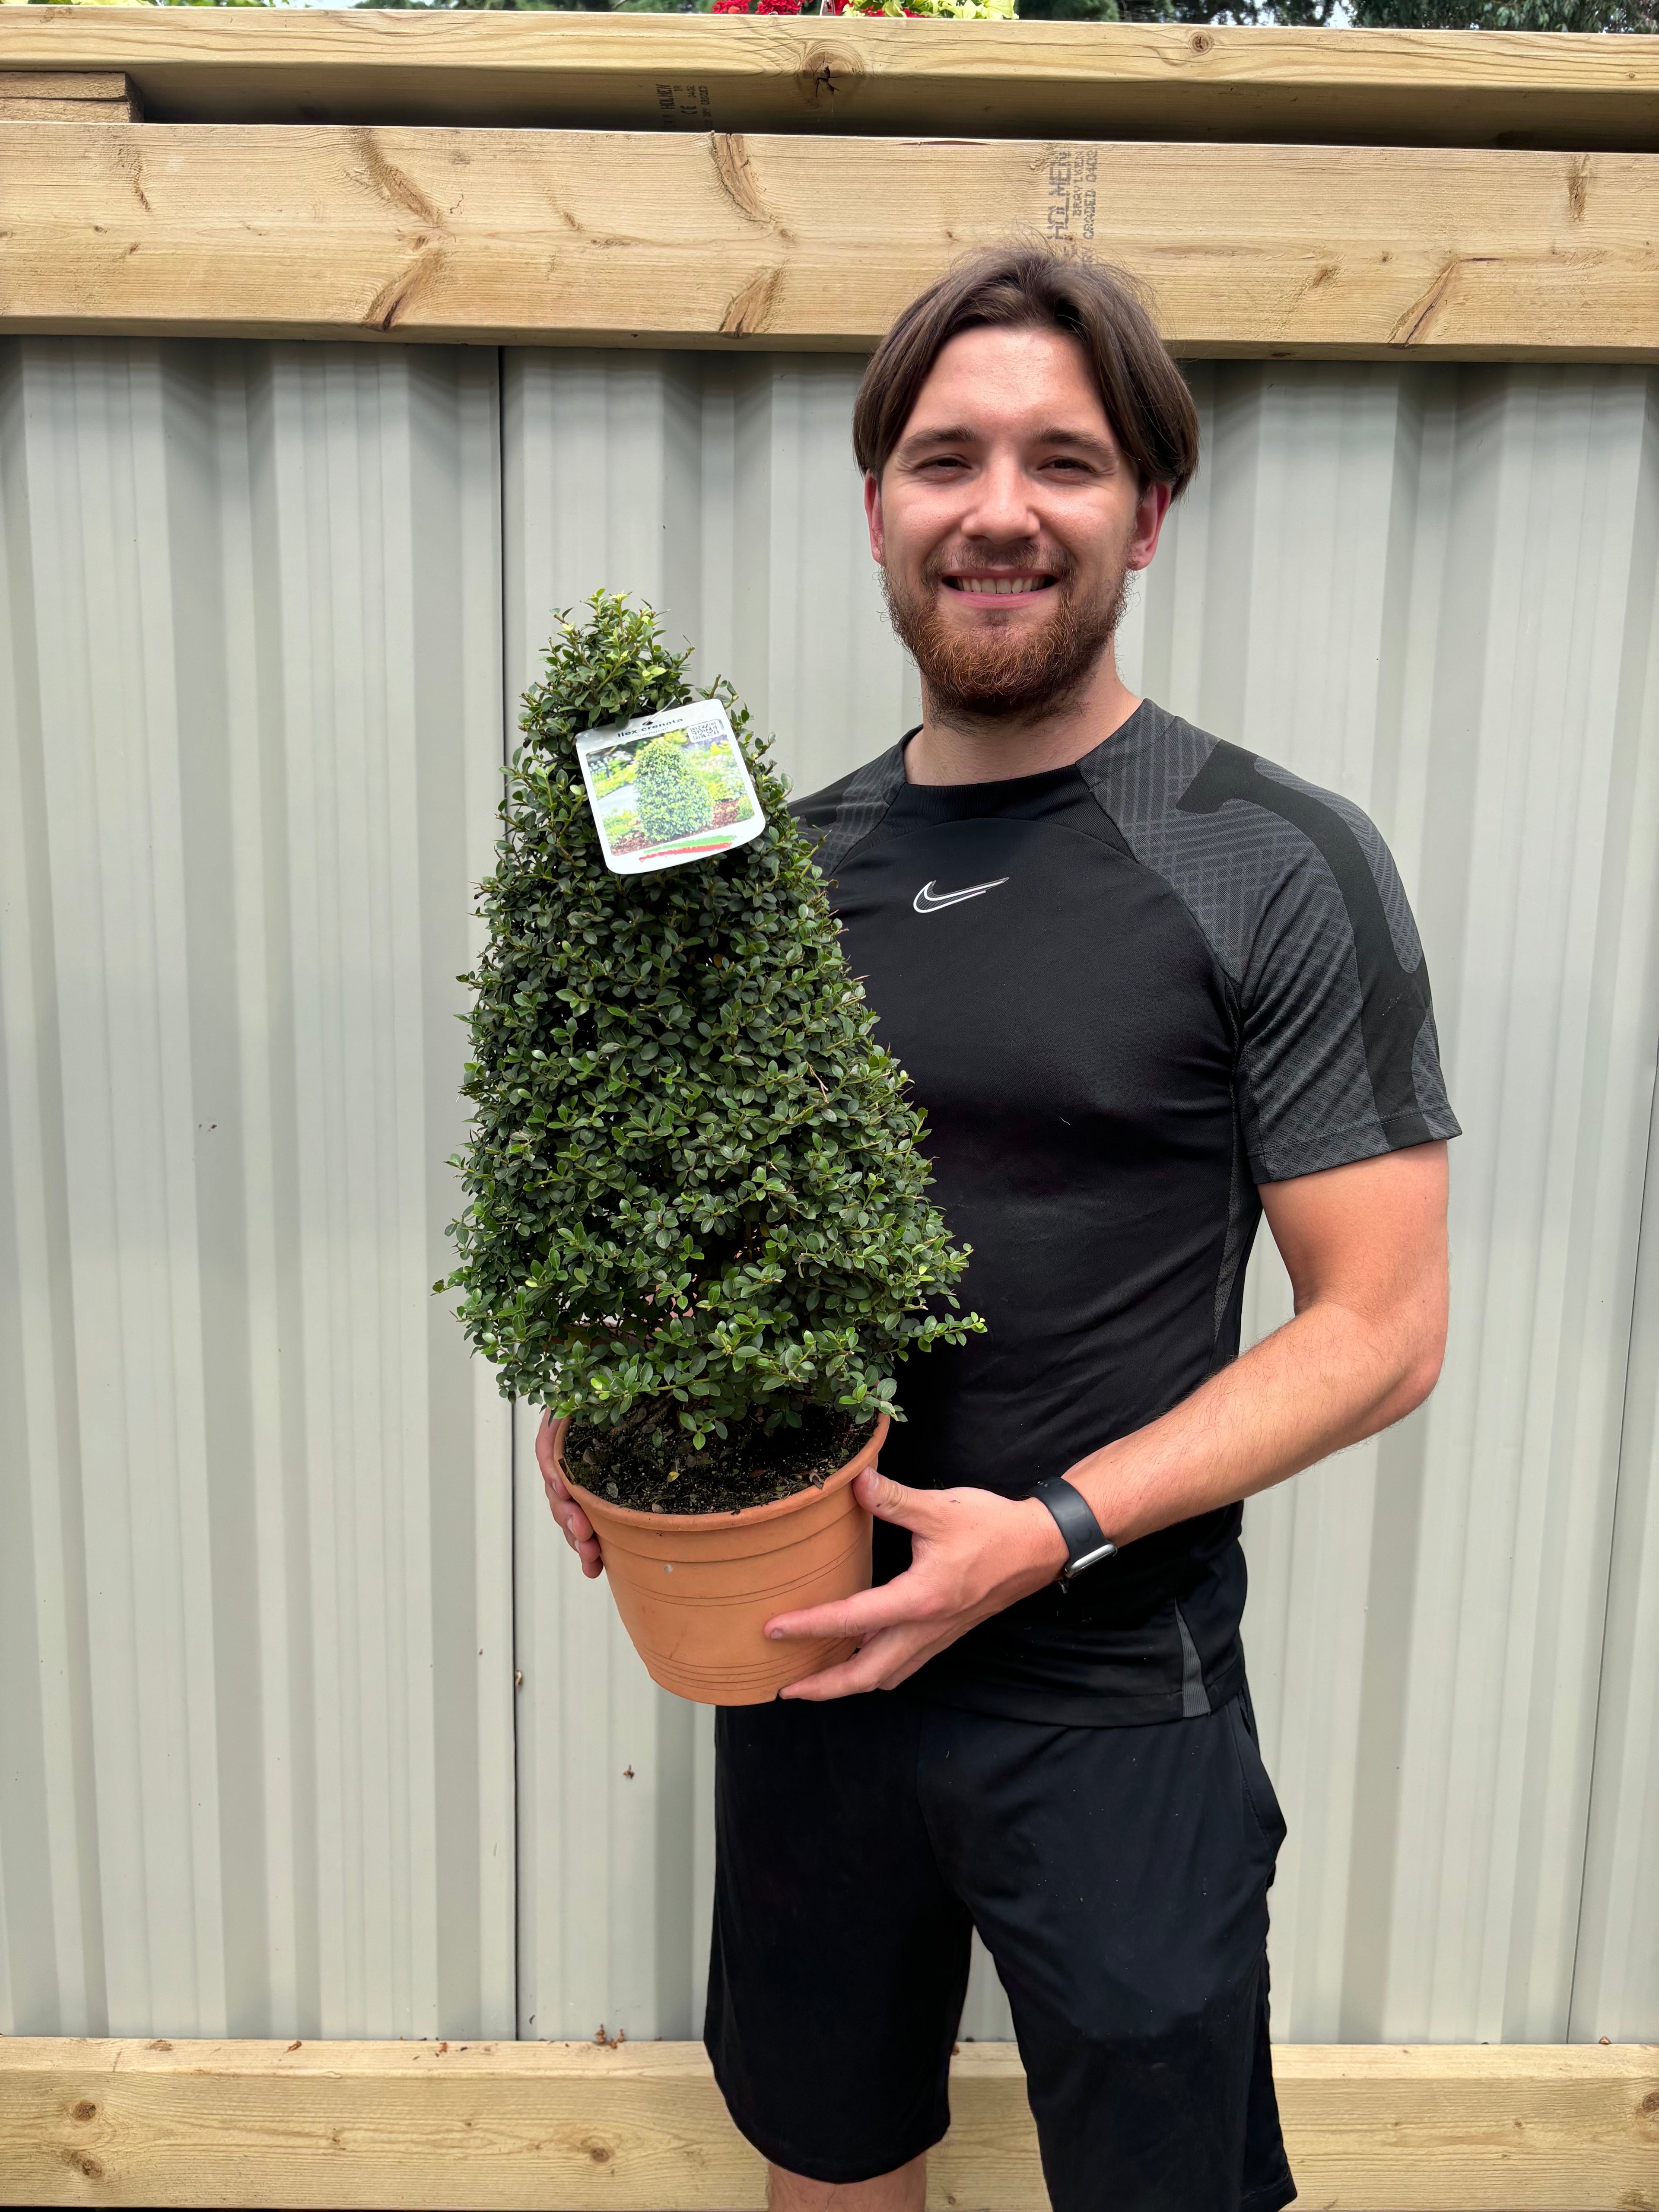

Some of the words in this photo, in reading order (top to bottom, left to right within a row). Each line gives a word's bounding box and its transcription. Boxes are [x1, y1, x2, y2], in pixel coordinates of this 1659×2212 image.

[655, 84, 675, 109] HOLMEN
[1047, 151, 1071, 239] HOLMEN
[1083, 190, 1096, 239] GRADED
[641, 718, 683, 731] crenata
